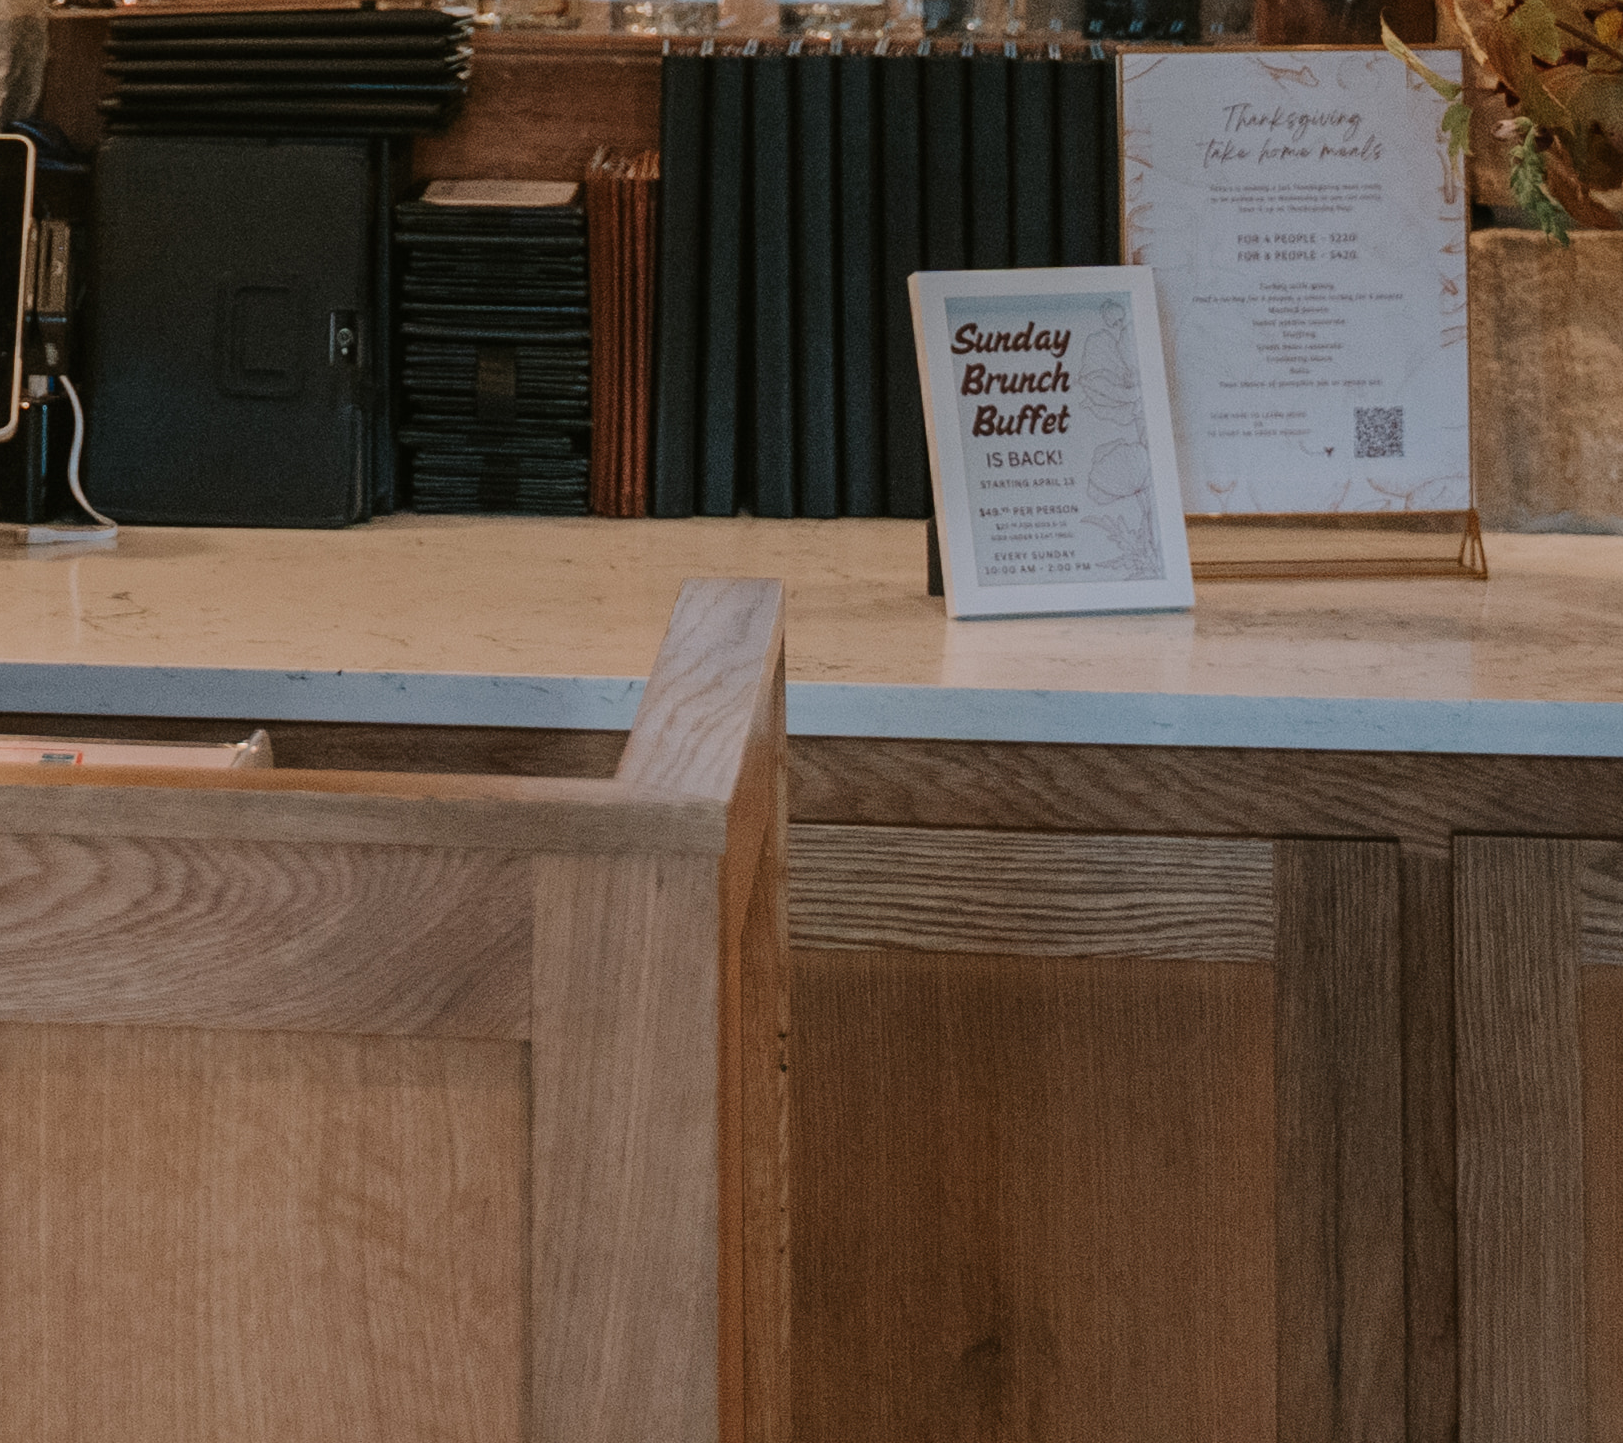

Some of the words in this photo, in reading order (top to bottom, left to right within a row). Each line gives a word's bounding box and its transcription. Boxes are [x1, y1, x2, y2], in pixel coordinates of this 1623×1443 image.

[1222, 102, 1362, 143] Thanksgiving
[1195, 137, 1250, 169] take
[1257, 137, 1312, 165] home
[1237, 233, 1259, 244] FOR
[1274, 232, 1316, 244] PEOPLE
[1237, 250, 1259, 262] FOR
[1274, 250, 1316, 261] PEOPLE
[950, 321, 1071, 358] Sunday
[961, 361, 1071, 396] Brunch
[972, 403, 1071, 437] Buffet
[986, 452, 1004, 468] IS
[1008, 449, 1064, 468] BACK!
[979, 478, 1029, 489] STARTING
[1032, 477, 1061, 488] APRIL
[1012, 506, 1033, 516] PER
[1036, 504, 1079, 515] PERSON
[994, 552, 1027, 561] EVERY
[1031, 550, 1076, 560] SUNDAY
[1020, 564, 1035, 573] AM
[1048, 563, 1071, 572] 2:00
[1075, 562, 1091, 571] PM
